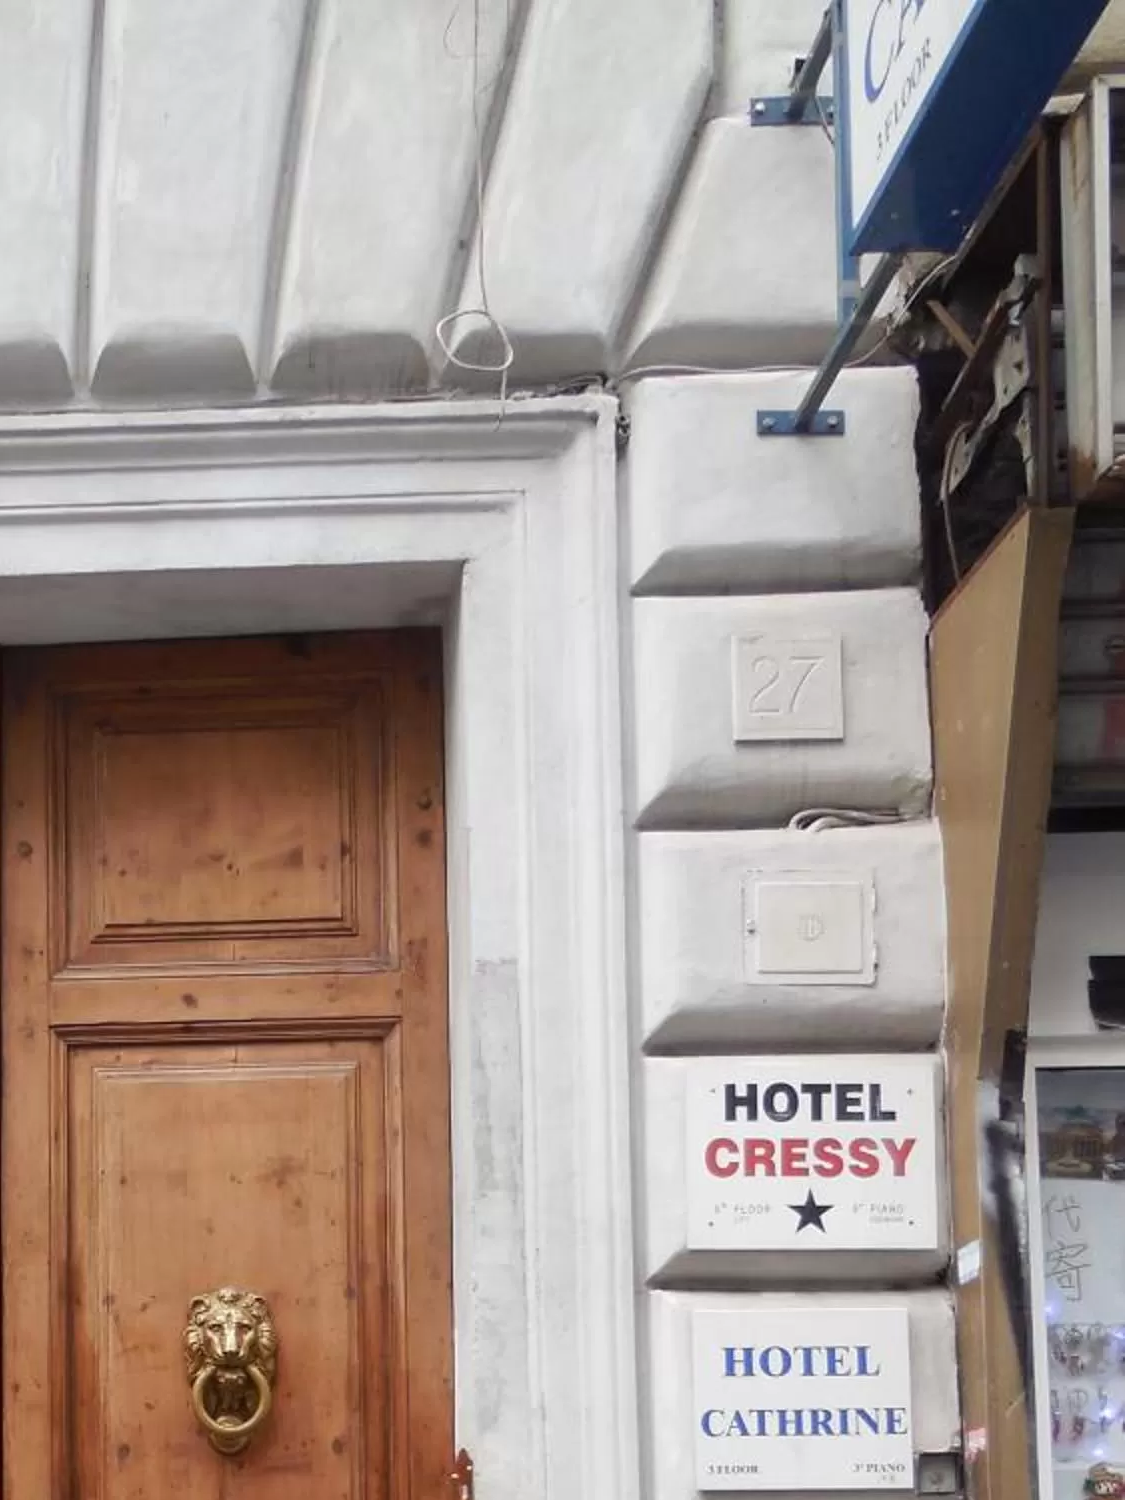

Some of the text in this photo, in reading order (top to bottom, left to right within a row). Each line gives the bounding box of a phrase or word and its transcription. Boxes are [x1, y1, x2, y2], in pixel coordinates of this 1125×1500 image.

[885, 36, 932, 143] FLOOR
[748, 654, 826, 717] 27
[723, 1082, 897, 1122] HOTEL
[704, 1137, 918, 1178] CRESSY
[722, 1345, 881, 1378] HOTEL
[700, 1407, 908, 1438] CATHRINE
[866, 1462, 907, 1474] PIANO
